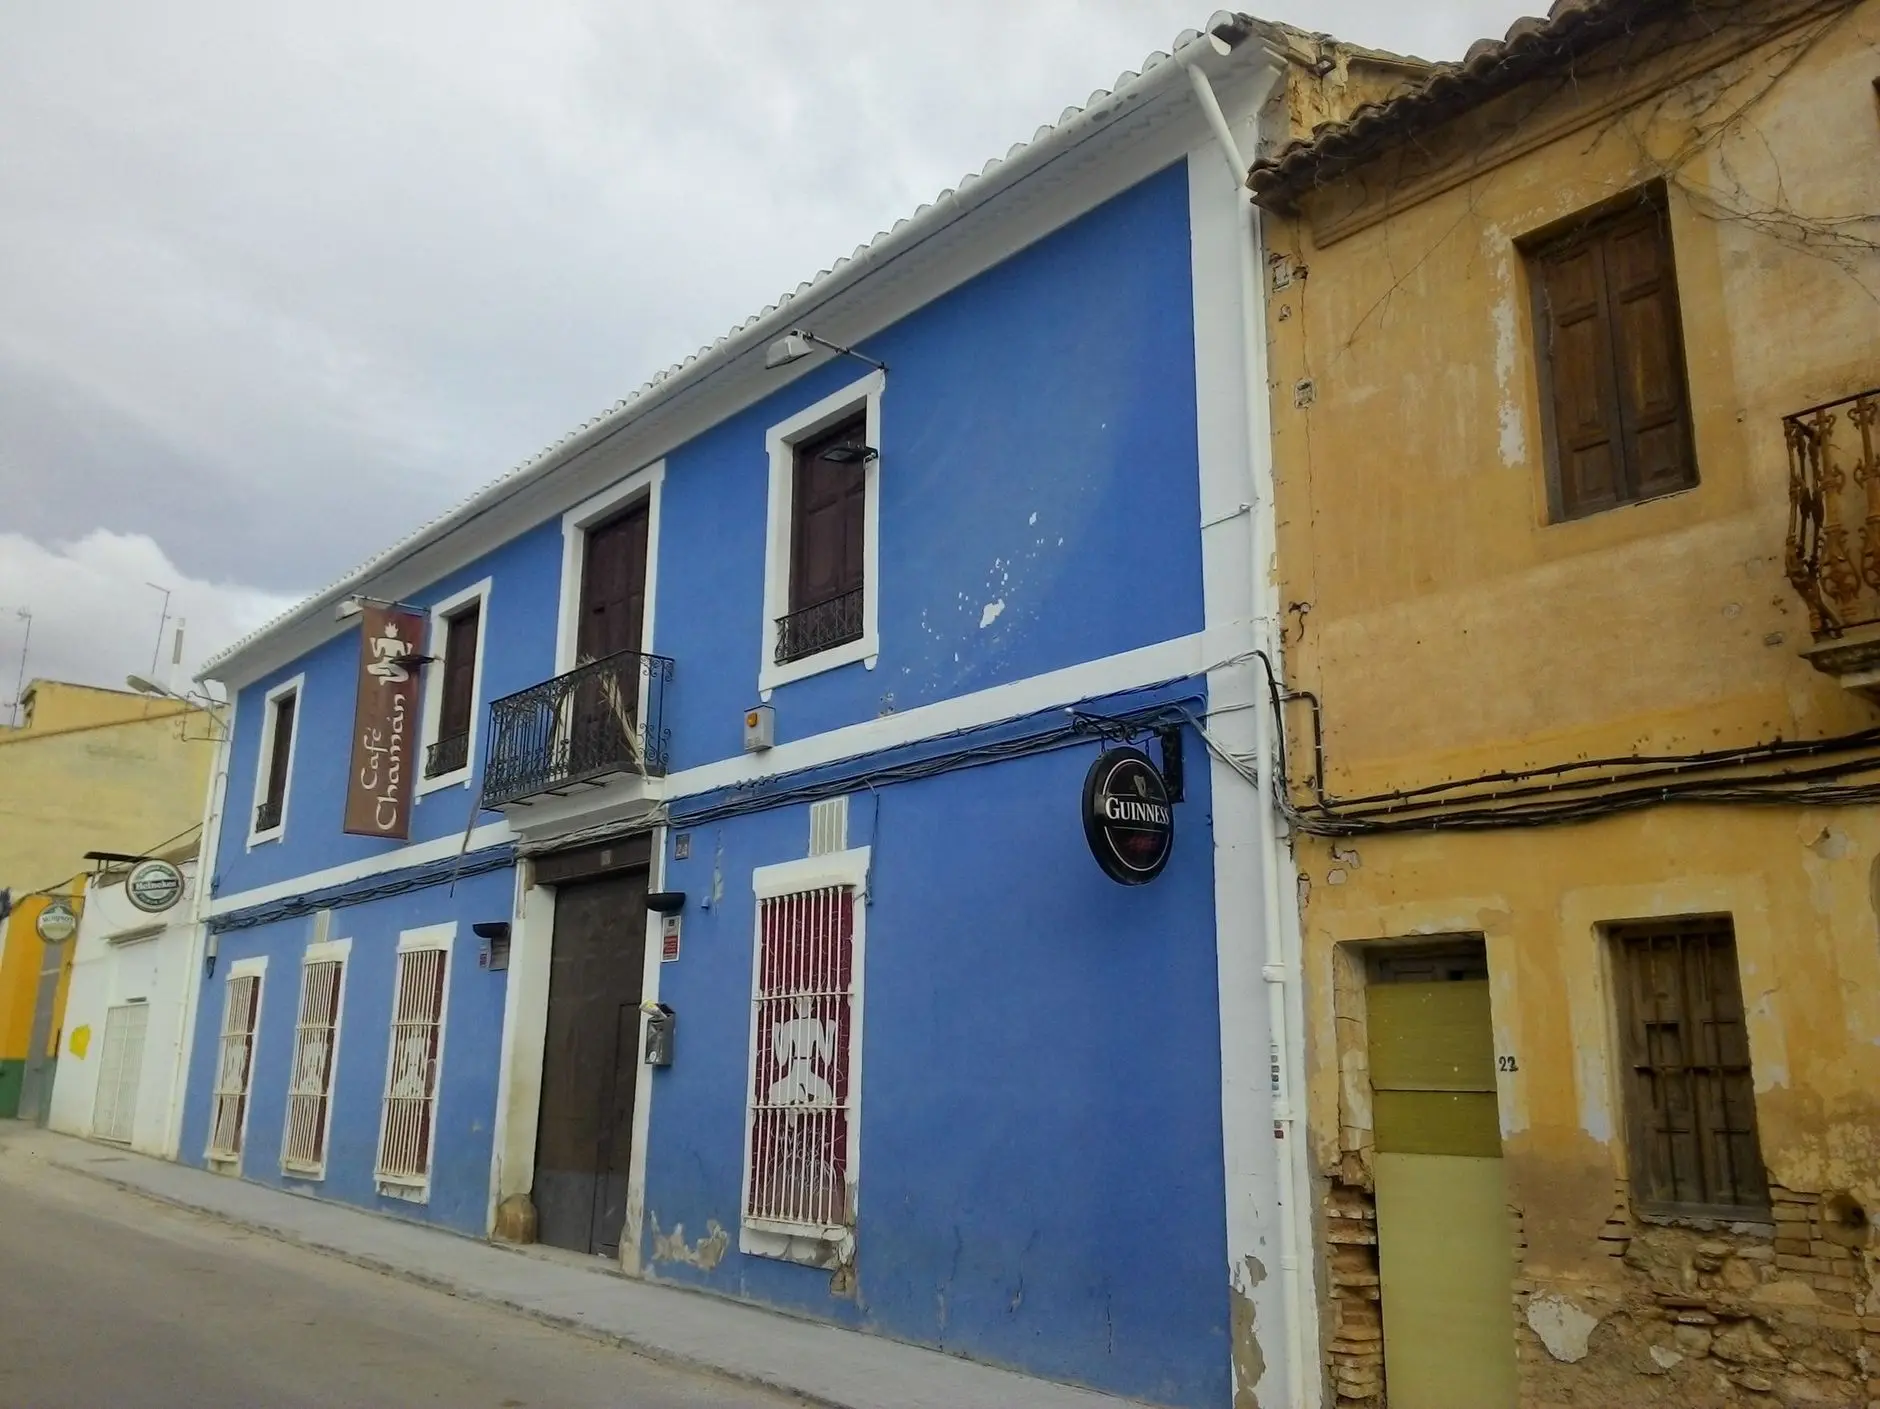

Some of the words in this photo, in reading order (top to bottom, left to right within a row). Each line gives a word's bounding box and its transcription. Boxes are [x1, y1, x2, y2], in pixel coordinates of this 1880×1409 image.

[360, 727, 388, 790] Café
[376, 693, 407, 830] Chamán
[1105, 796, 1170, 826] GUINNESS
[1498, 1055, 1520, 1072] 22
